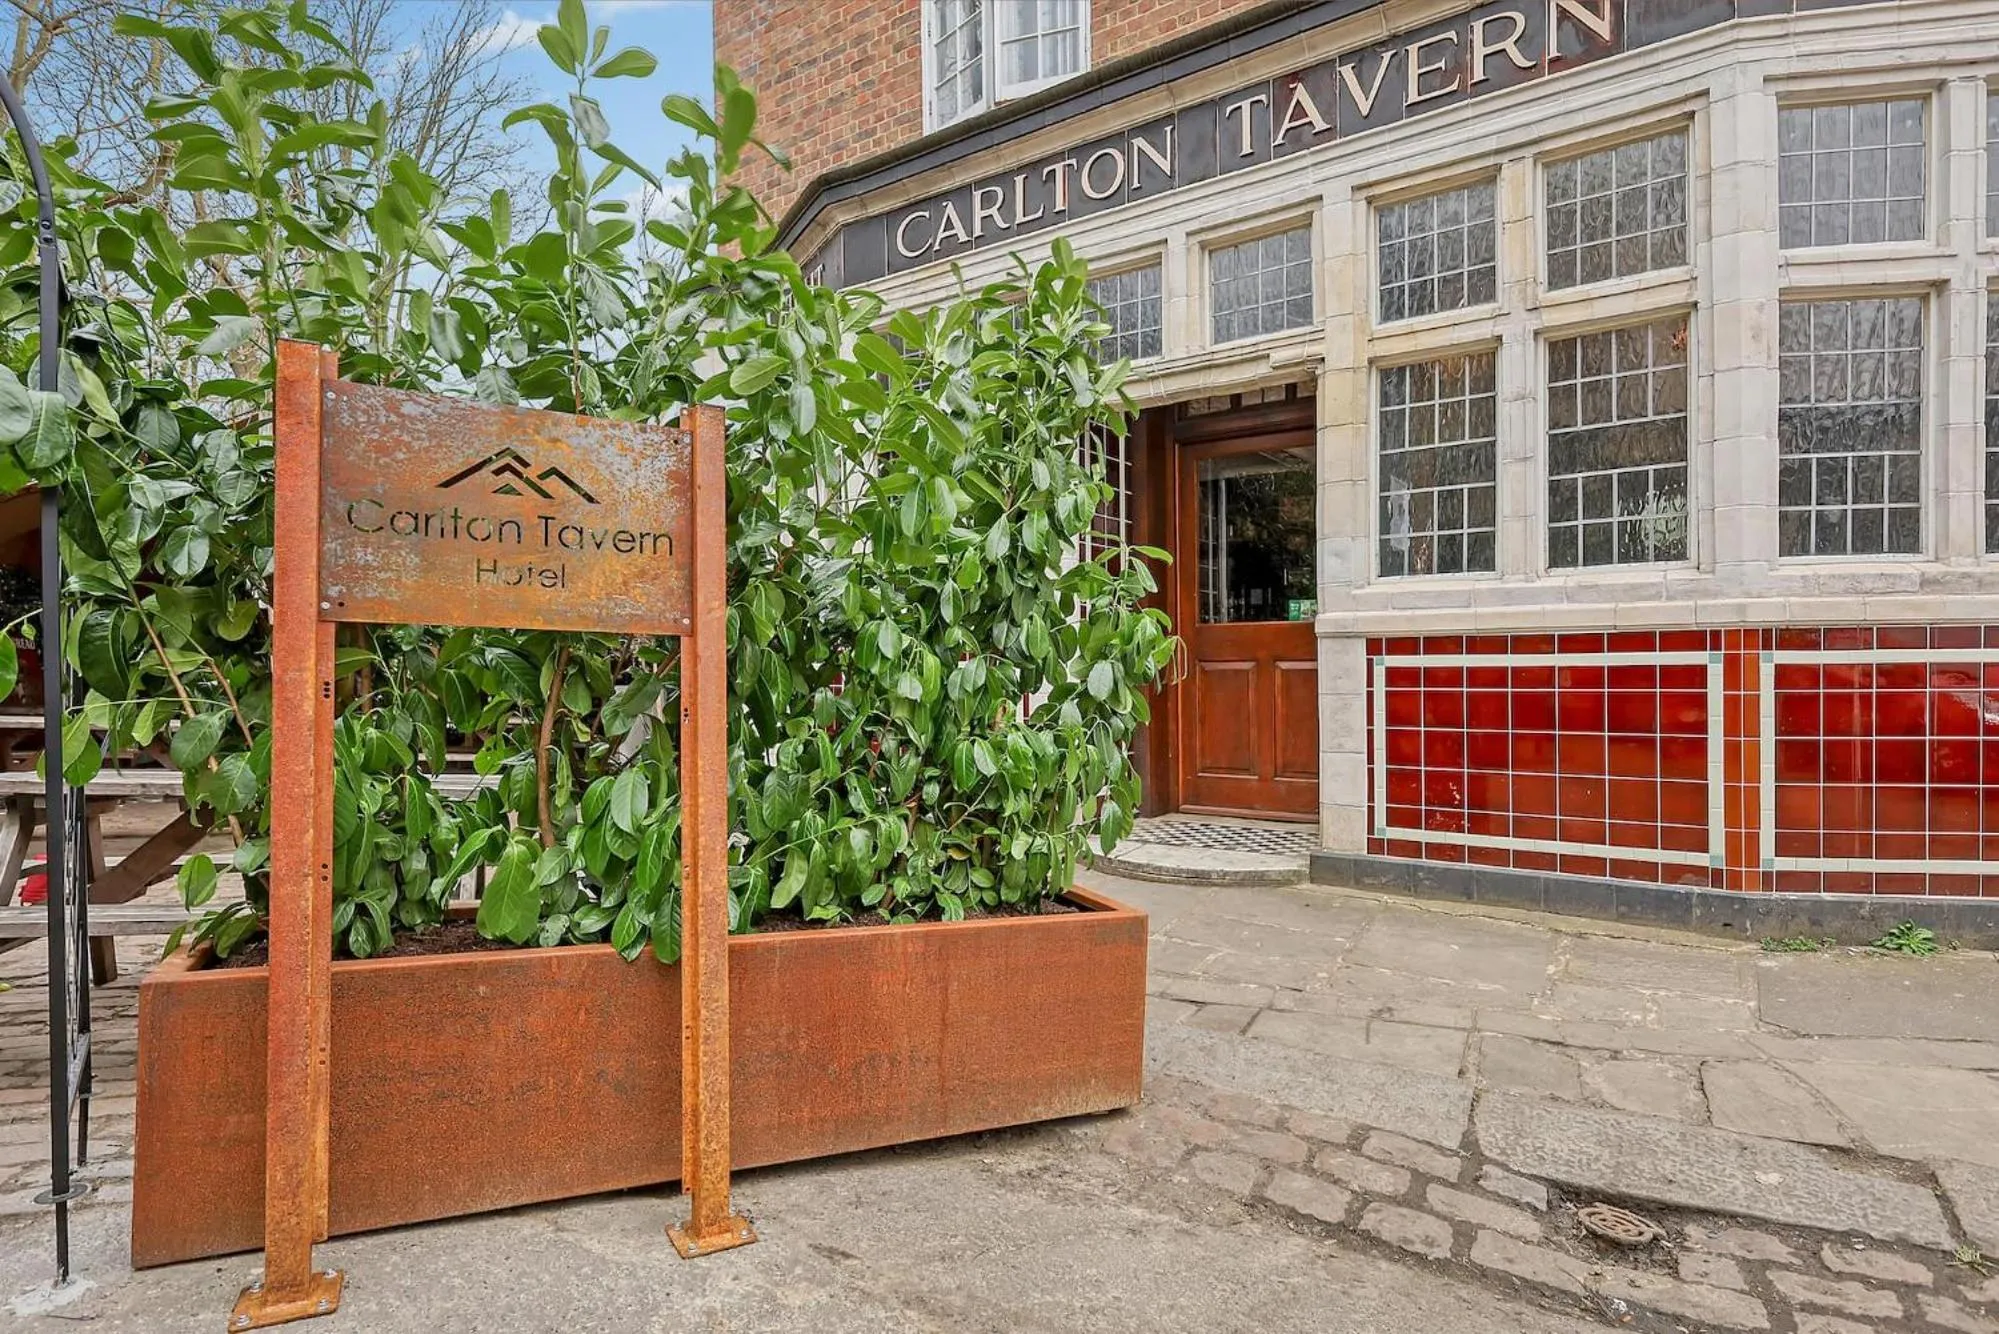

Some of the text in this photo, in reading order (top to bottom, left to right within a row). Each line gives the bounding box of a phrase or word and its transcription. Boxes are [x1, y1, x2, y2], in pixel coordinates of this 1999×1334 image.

[896, 0, 1612, 258] CARLTON TAVERN
[347, 498, 673, 557] Carlton Tavern
[476, 557, 566, 589] Hotel
